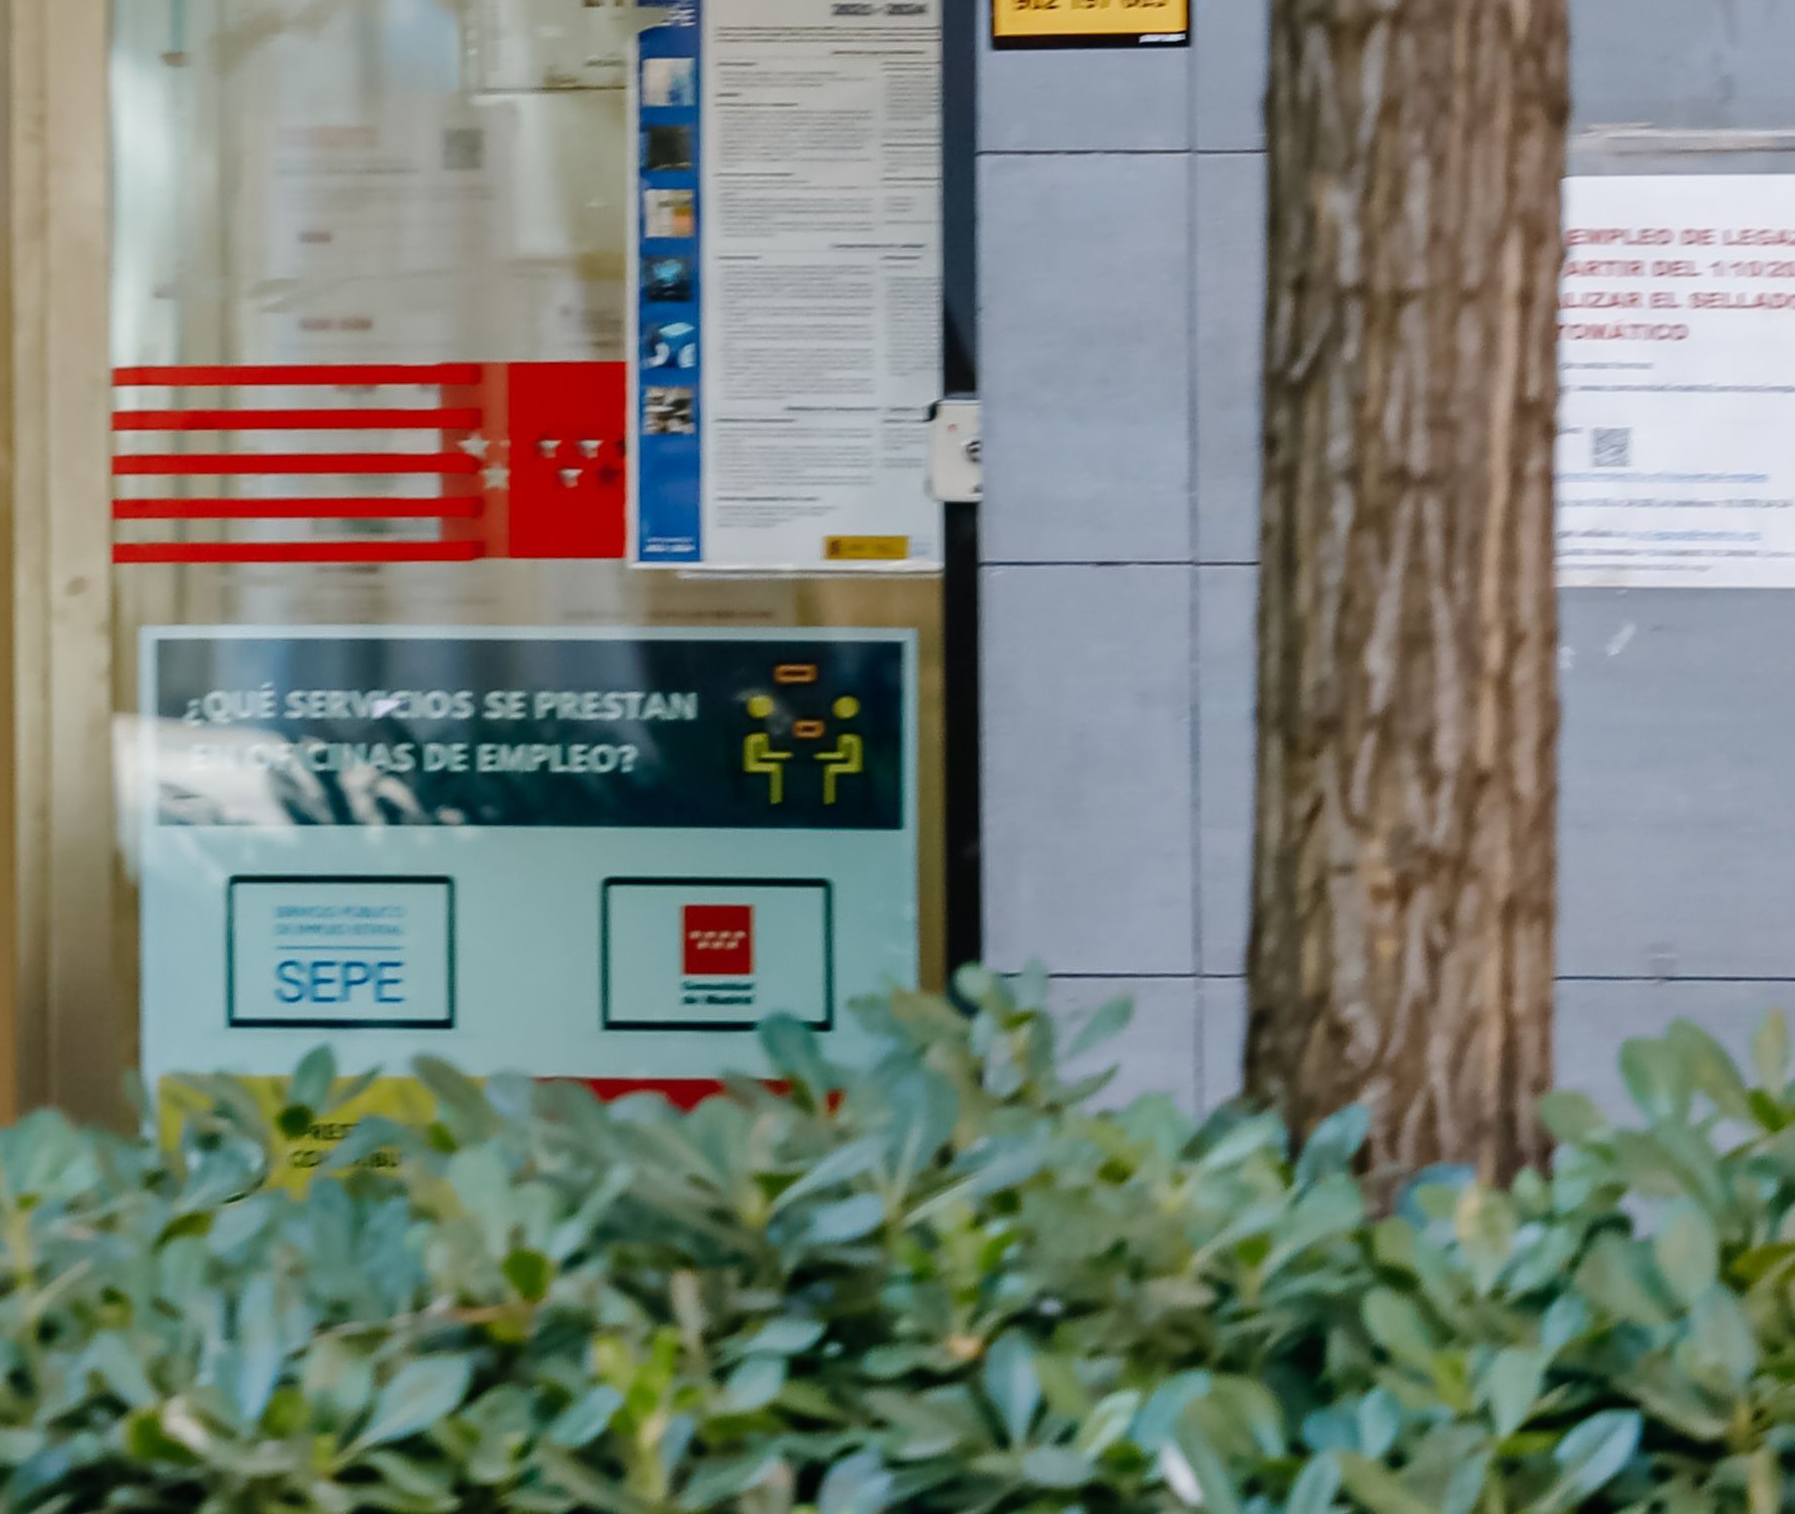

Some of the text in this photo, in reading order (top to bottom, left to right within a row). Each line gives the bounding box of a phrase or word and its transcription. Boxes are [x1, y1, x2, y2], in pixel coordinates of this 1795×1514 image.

[1565, 228, 1674, 246] EMPLEO
[1681, 228, 1715, 246] DE
[1561, 260, 1644, 277] ARTIR
[1651, 260, 1702, 277] DEL
[1558, 292, 1643, 309] LIZAR
[1650, 292, 1681, 309] EL
[483, 691, 525, 720] SE
[534, 691, 698, 721] PRESTAN
[422, 742, 469, 773] DE
[477, 743, 640, 774] EMPLEO?
[274, 958, 406, 1004] SEPE
